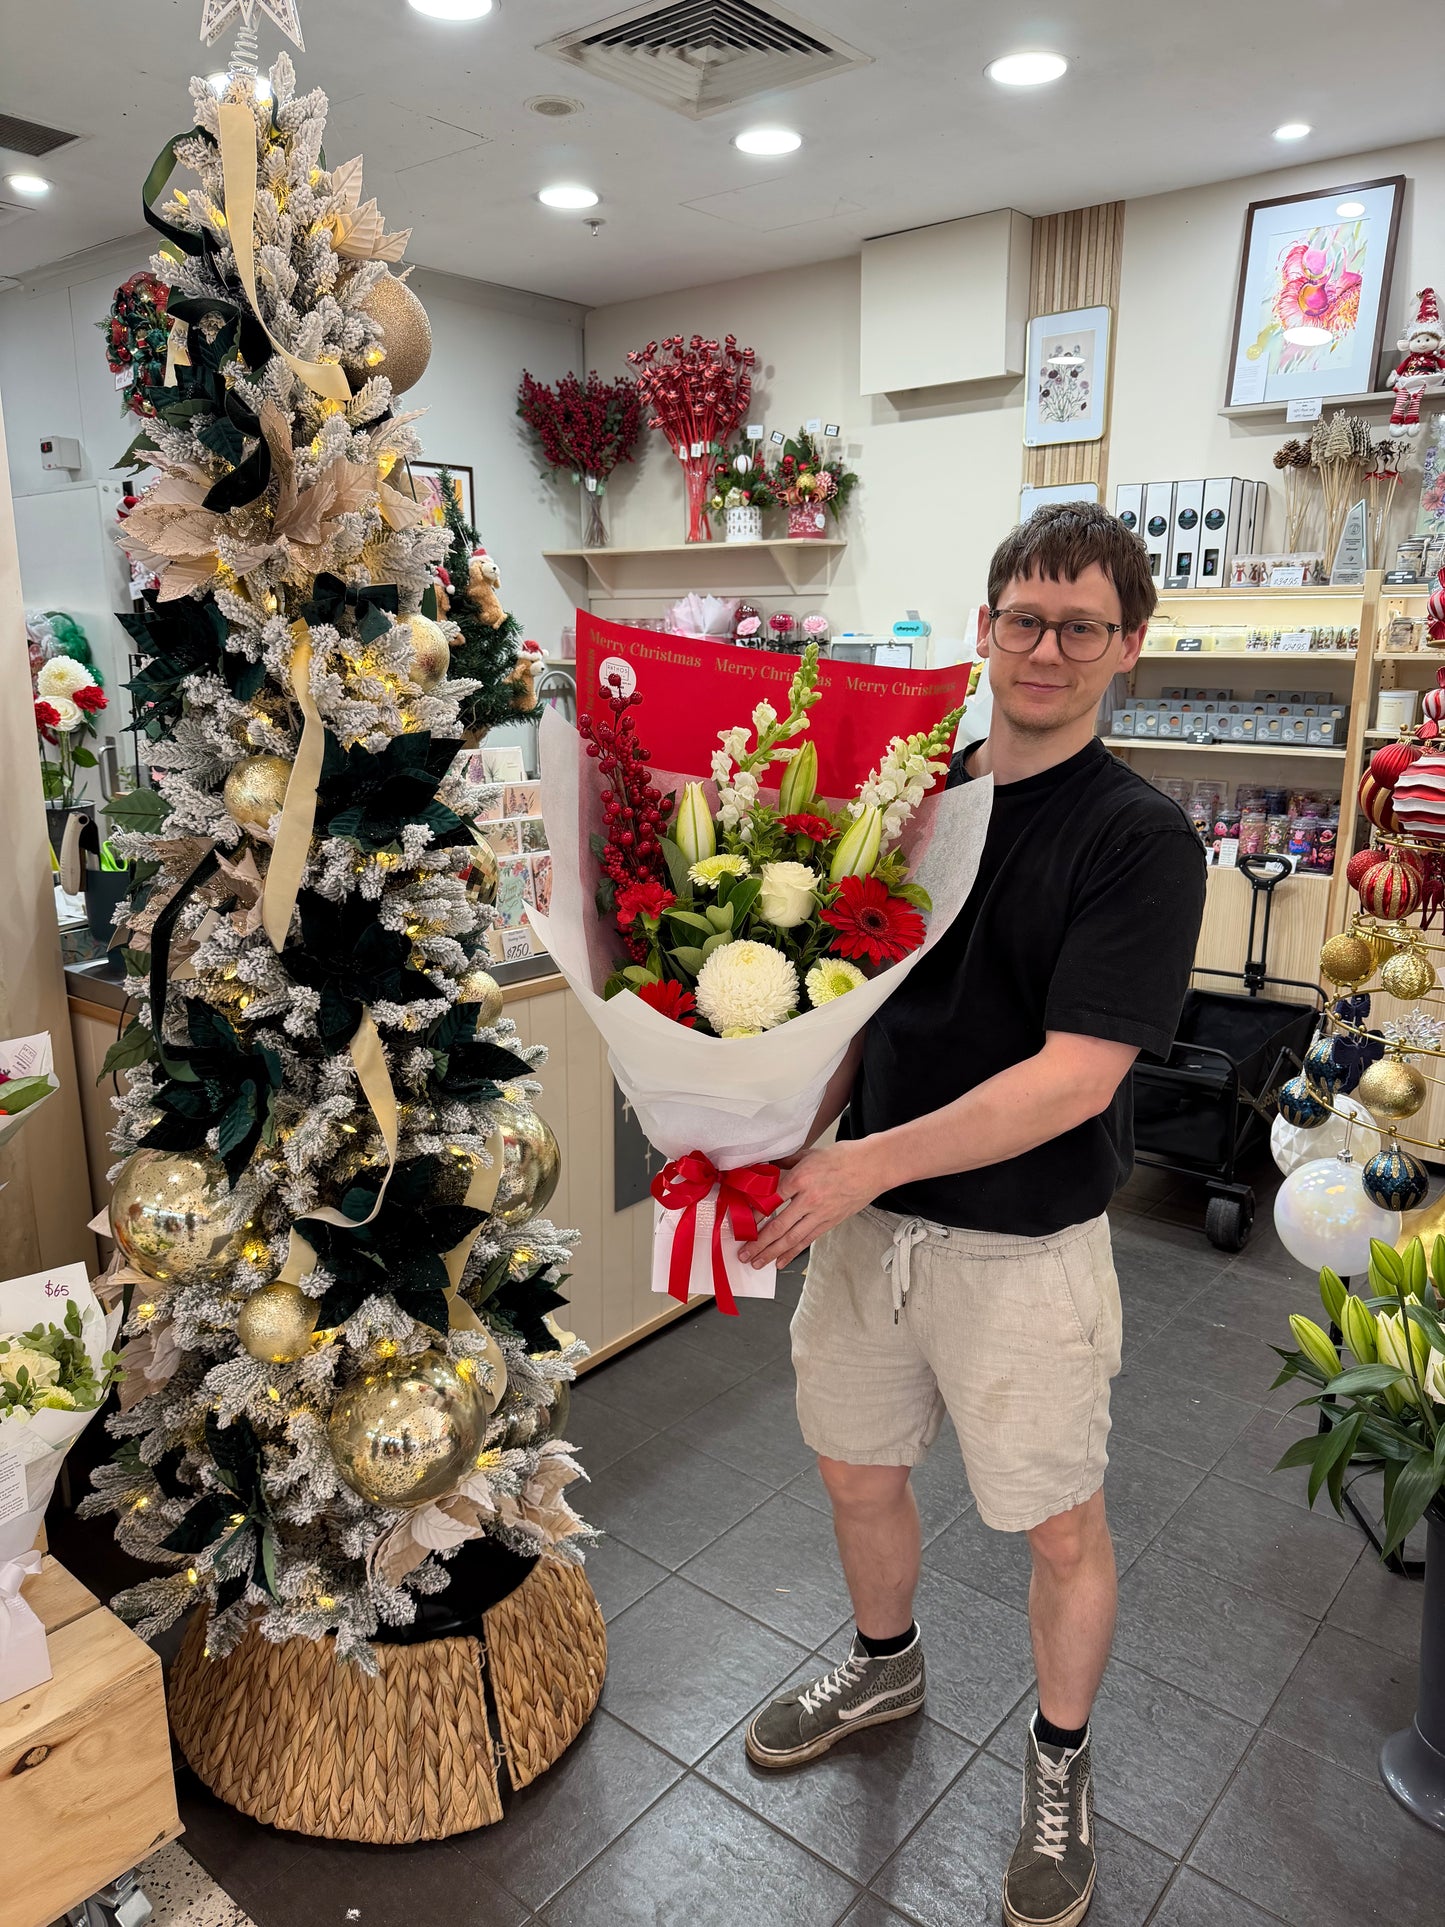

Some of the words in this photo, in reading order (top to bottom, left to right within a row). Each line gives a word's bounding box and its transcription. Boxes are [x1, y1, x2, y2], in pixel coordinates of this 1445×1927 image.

[589, 628, 626, 656] Merry
[630, 642, 701, 668] Christmas
[714, 657, 758, 680] Merry
[760, 665, 832, 687] Chrias
[845, 676, 889, 697] Merry
[891, 681, 956, 697] Christmas
[44, 1279, 70, 1298] $65
